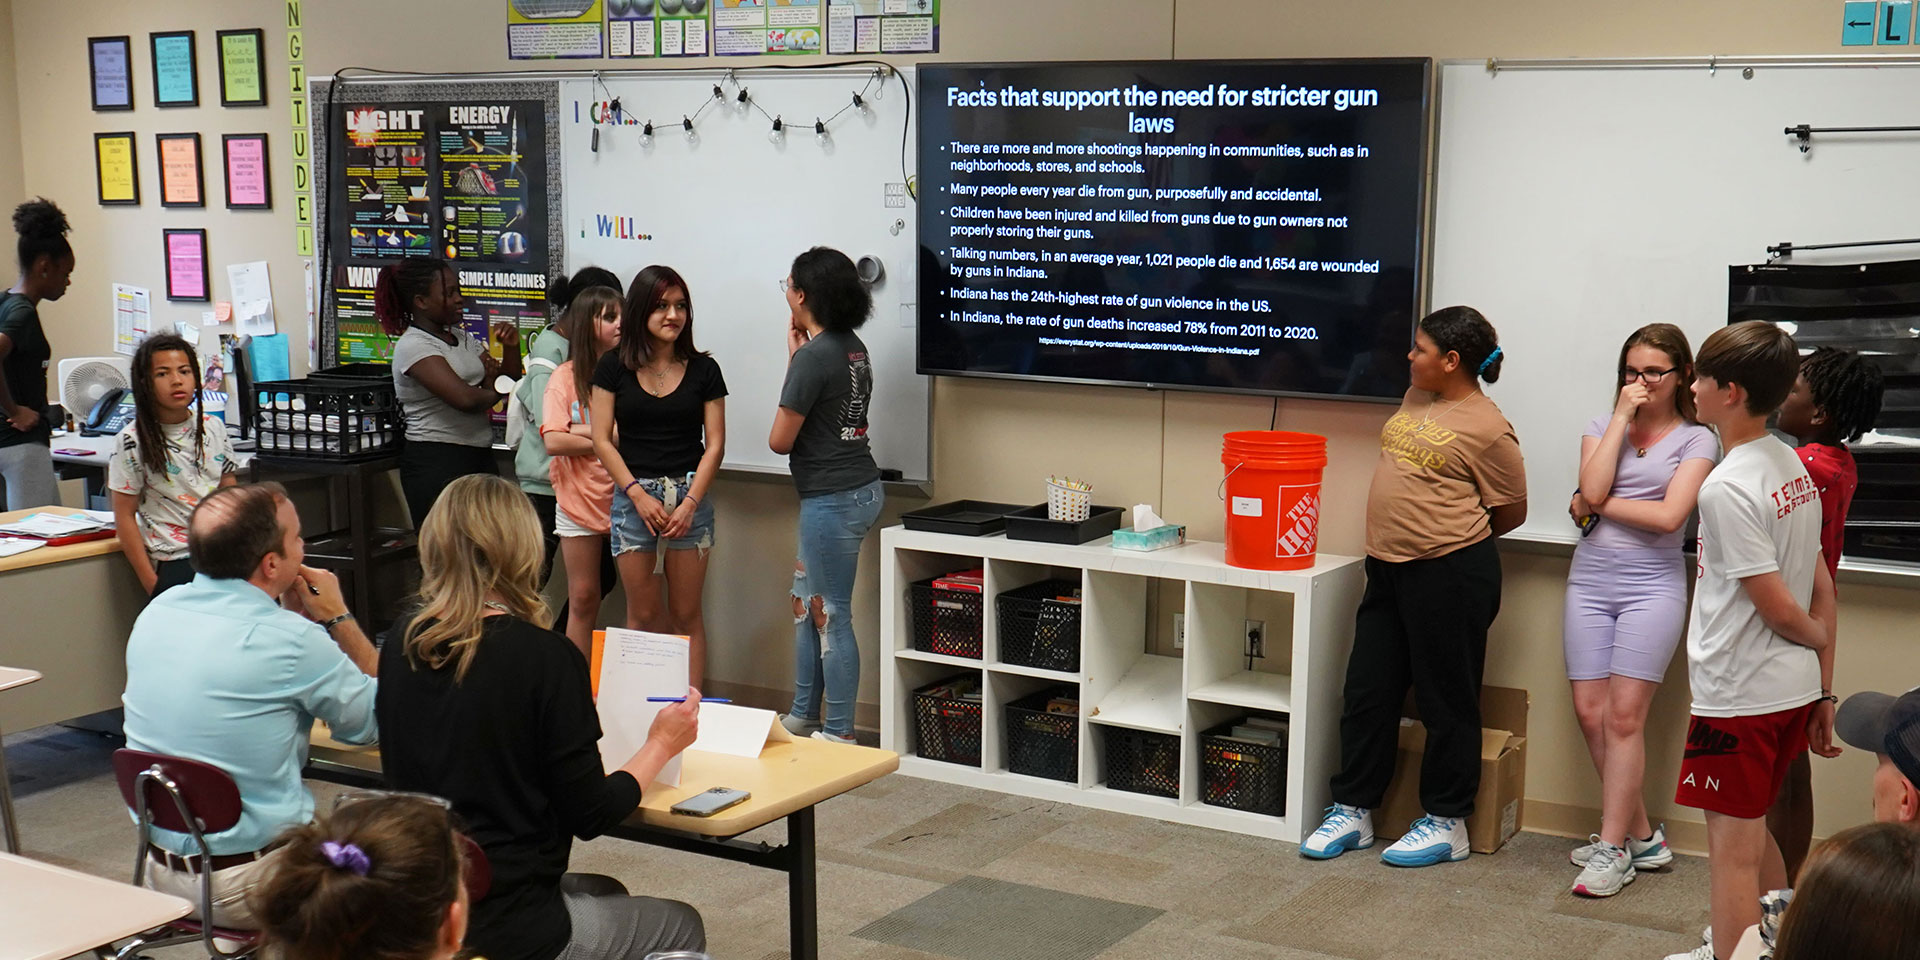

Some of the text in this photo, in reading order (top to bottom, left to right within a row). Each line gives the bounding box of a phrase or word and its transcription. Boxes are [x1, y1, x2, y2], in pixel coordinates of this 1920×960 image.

[947, 84, 1378, 110] Facts that support the need for stricter gun
[346, 110, 424, 130] LIGHT
[450, 106, 510, 124] ENERGY
[1128, 112, 1174, 133] laws
[950, 141, 1369, 158] There are more and more shootings happening in communities, such as in
[950, 159, 1145, 174] neighborhoods, stores, and schools.
[950, 182, 1322, 202] Many people every year die from gun, purposefully and accidental.
[950, 206, 1348, 228] Children have been injured and killed from guns due to gun owners not
[950, 224, 1094, 240] properly storing their guns.
[950, 246, 1379, 273] Talking numbers, in an average year, 1,021 people die and 1,654 are wounded
[459, 271, 546, 289] SIMPLE MACHINES
[950, 264, 1048, 278] by guns in Indiana.
[950, 287, 1272, 312] Indiana has the 24th-highest rate of gun violence in the US.
[950, 310, 1318, 340] In Indiana, the rate of gun deaths increased 78% from 2011 to 2020.
[1286, 492, 1313, 522] THE
